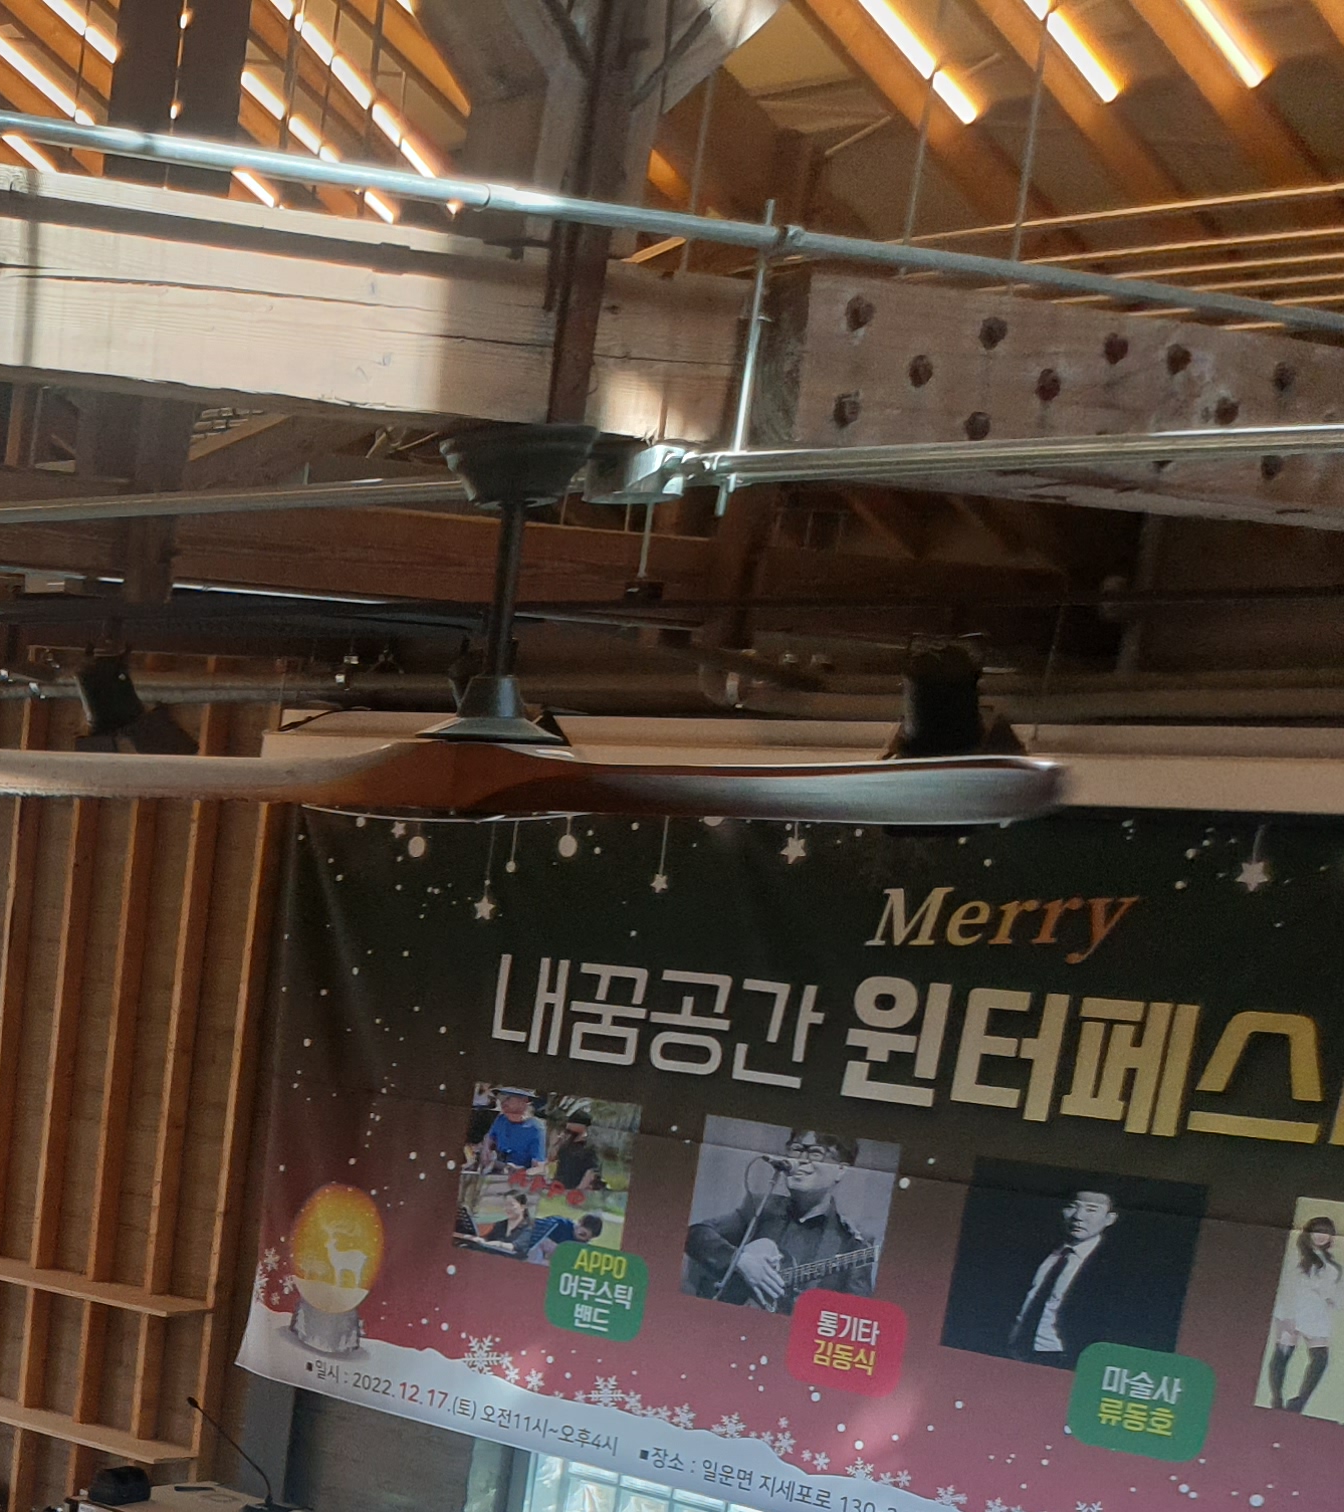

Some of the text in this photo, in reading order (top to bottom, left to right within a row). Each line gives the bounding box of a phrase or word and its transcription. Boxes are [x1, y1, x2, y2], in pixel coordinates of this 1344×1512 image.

[865, 886, 1142, 964] Merry
[490, 953, 1344, 1147] 내꿈공간 윈터페스
[573, 1248, 628, 1280] APPO
[559, 1272, 634, 1311] 어쿠스틱
[573, 1303, 610, 1333] 밴드
[816, 1310, 881, 1346] 통기타
[813, 1339, 877, 1377] 김동식
[1101, 1365, 1183, 1405] 마술사
[1097, 1397, 1175, 1438] 류동호
[701, 1459, 755, 1492] 일운면
[758, 1473, 832, 1511] 지세포로
